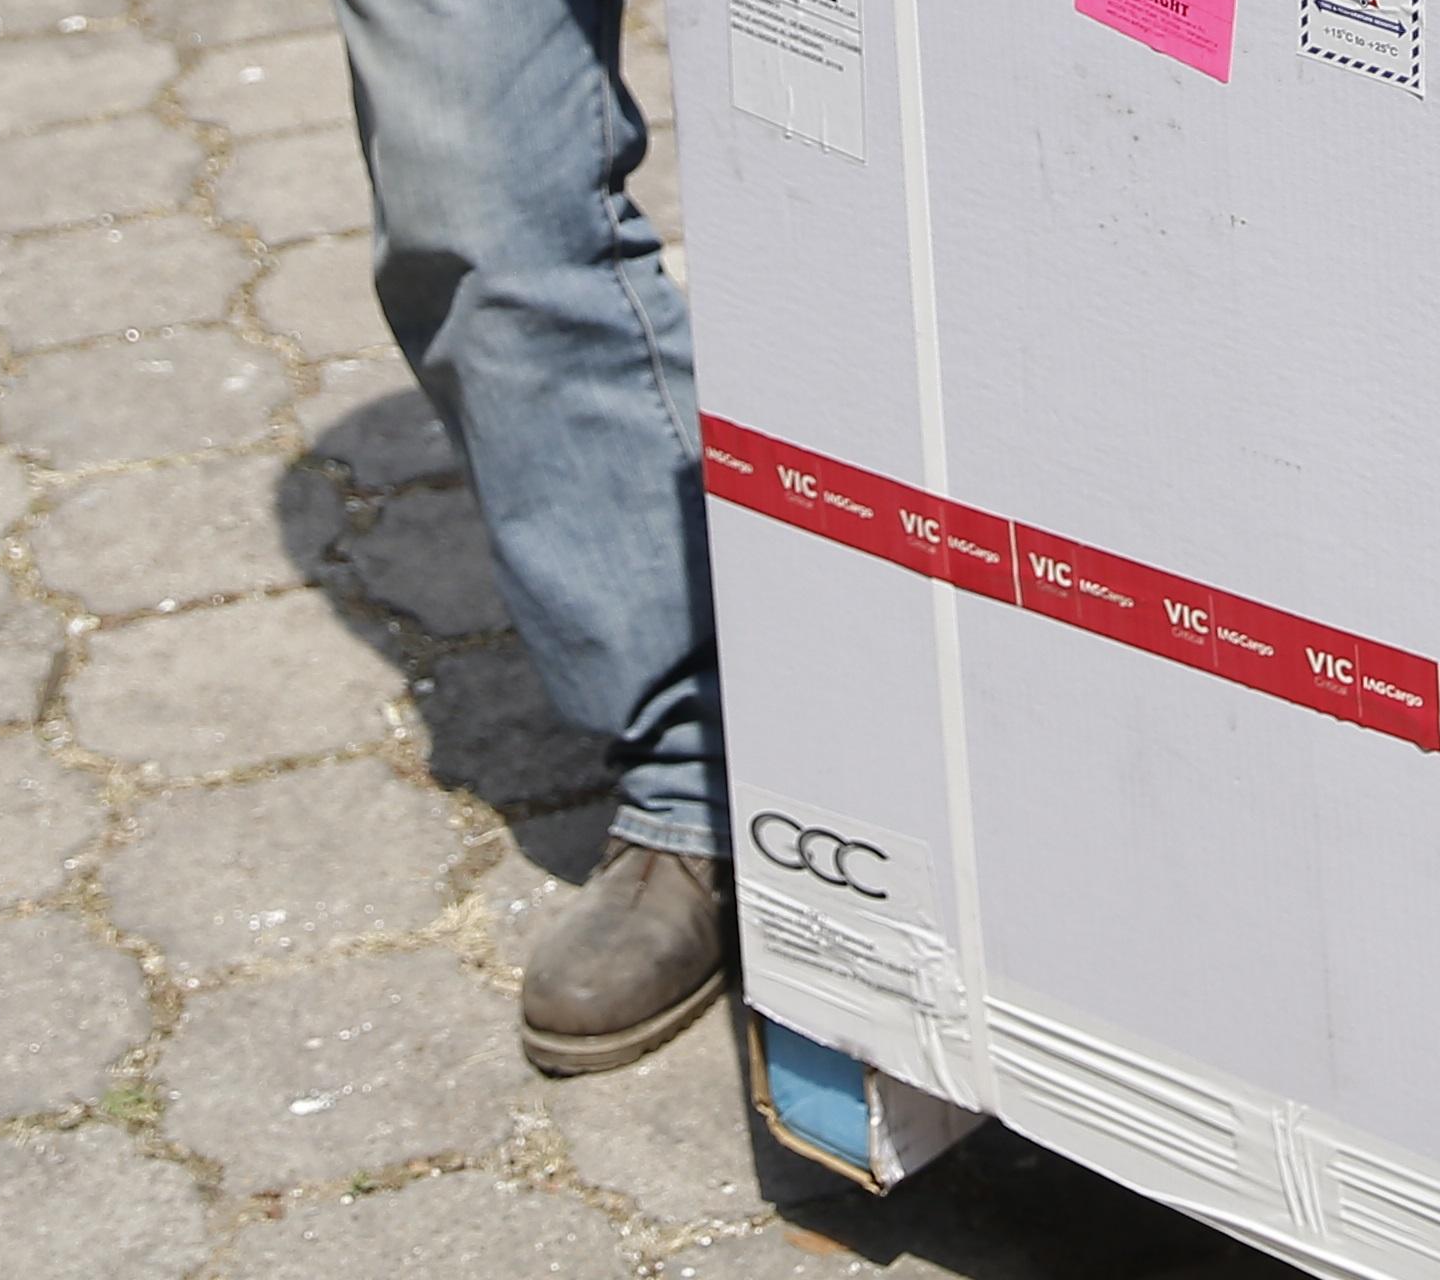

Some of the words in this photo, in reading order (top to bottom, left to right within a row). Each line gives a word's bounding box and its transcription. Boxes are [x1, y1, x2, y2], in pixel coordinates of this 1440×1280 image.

[1323, 26, 1354, 43] +15°C
[1355, 34, 1365, 46] to
[1368, 39, 1399, 57] +25°C
[776, 463, 818, 499] VIC
[898, 508, 941, 544] VIC
[1028, 552, 1073, 588] VIC
[1163, 598, 1210, 635] VIC
[1304, 647, 1355, 685] VIC
